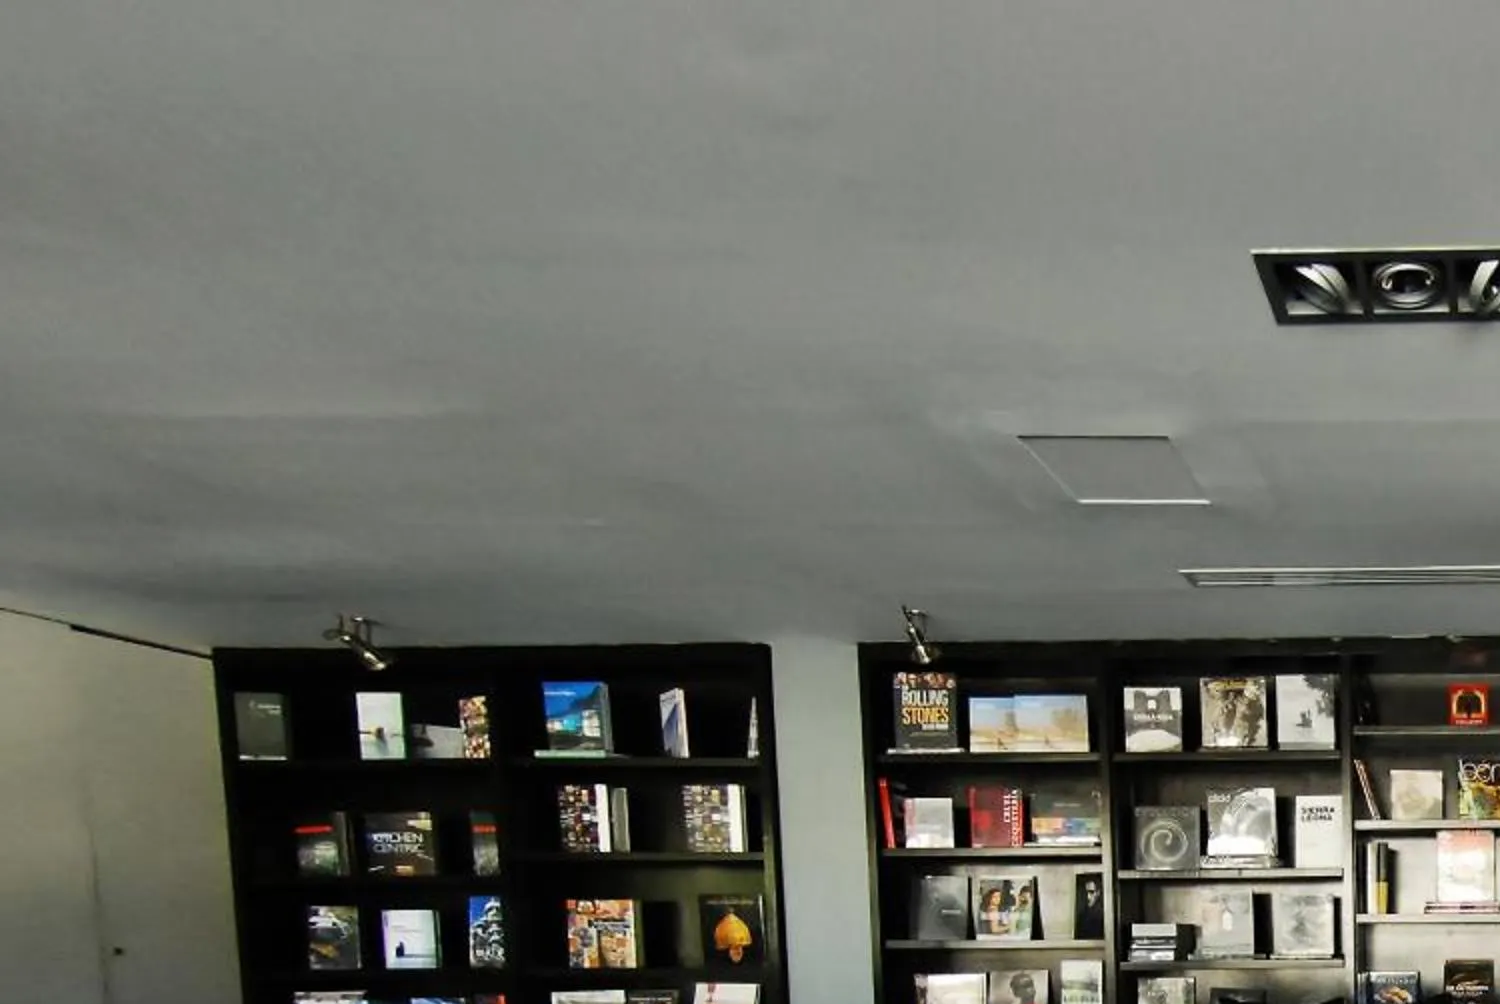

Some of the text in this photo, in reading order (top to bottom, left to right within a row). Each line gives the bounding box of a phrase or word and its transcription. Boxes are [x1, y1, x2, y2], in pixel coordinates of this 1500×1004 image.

[901, 688, 949, 707] ROLLING
[901, 707, 951, 725] STONES
[371, 832, 424, 843] KITCHEN
